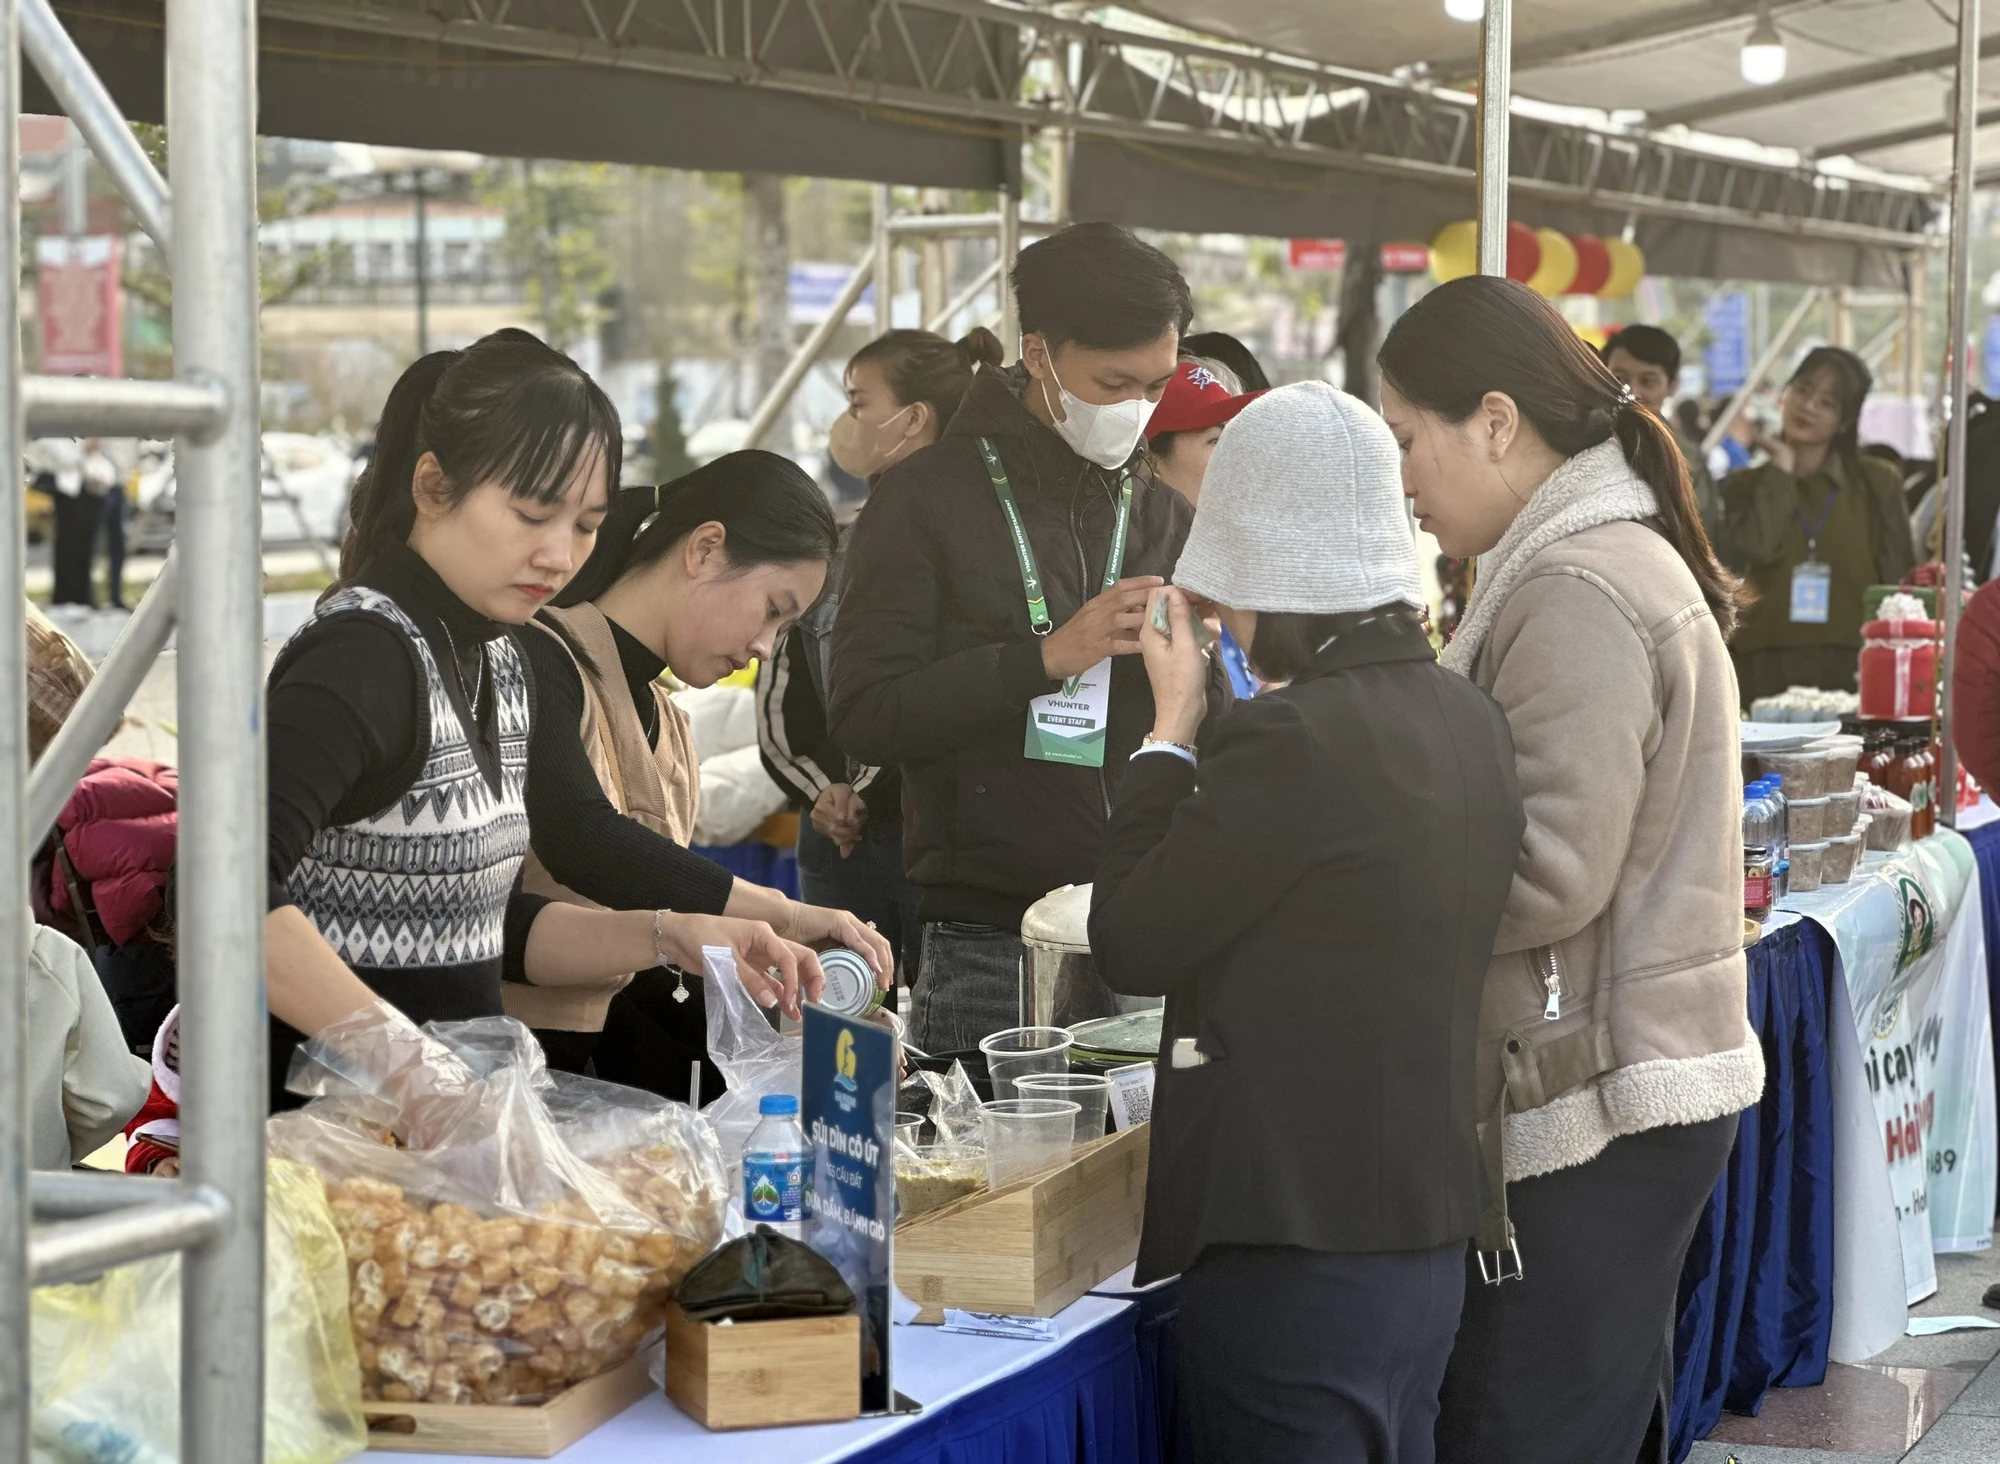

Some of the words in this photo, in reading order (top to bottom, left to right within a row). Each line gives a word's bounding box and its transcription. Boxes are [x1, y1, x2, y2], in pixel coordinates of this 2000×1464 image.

[1047, 699, 1090, 711] VHUNTER
[1047, 715, 1067, 724] EVENT
[1067, 717, 1087, 727] STAFF
[812, 1116, 828, 1145] SỦI
[829, 1124, 847, 1154] DÌN
[848, 1133, 863, 1159] CÔ
[865, 1138, 879, 1166] ÚT
[869, 1217, 885, 1241] GIÒ
